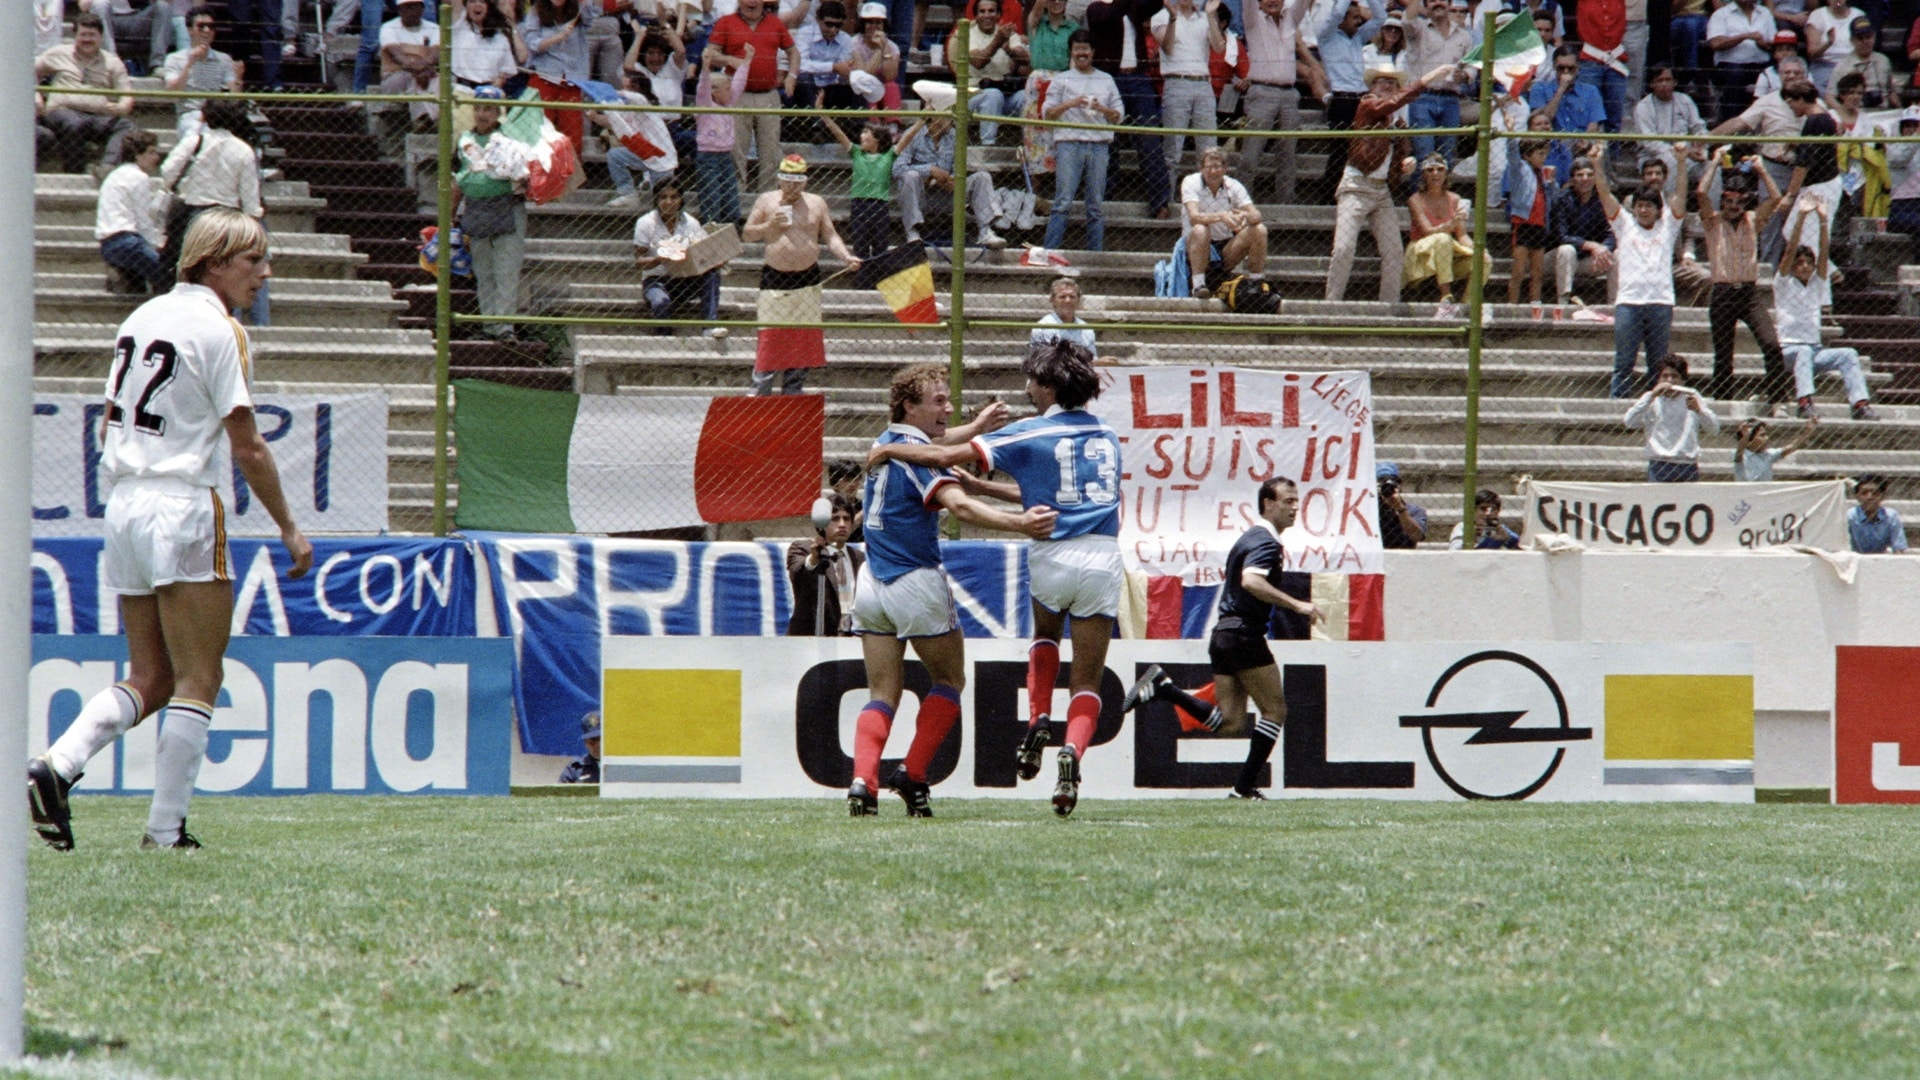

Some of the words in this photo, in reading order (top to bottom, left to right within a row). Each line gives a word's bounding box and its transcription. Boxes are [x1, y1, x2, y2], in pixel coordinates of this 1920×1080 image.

[107, 335, 180, 437] 22
[1054, 437, 1119, 506] 13
[1537, 495, 1715, 547] CHICAGO
[315, 547, 454, 623] CON
[796, 658, 1416, 790] OPEL
